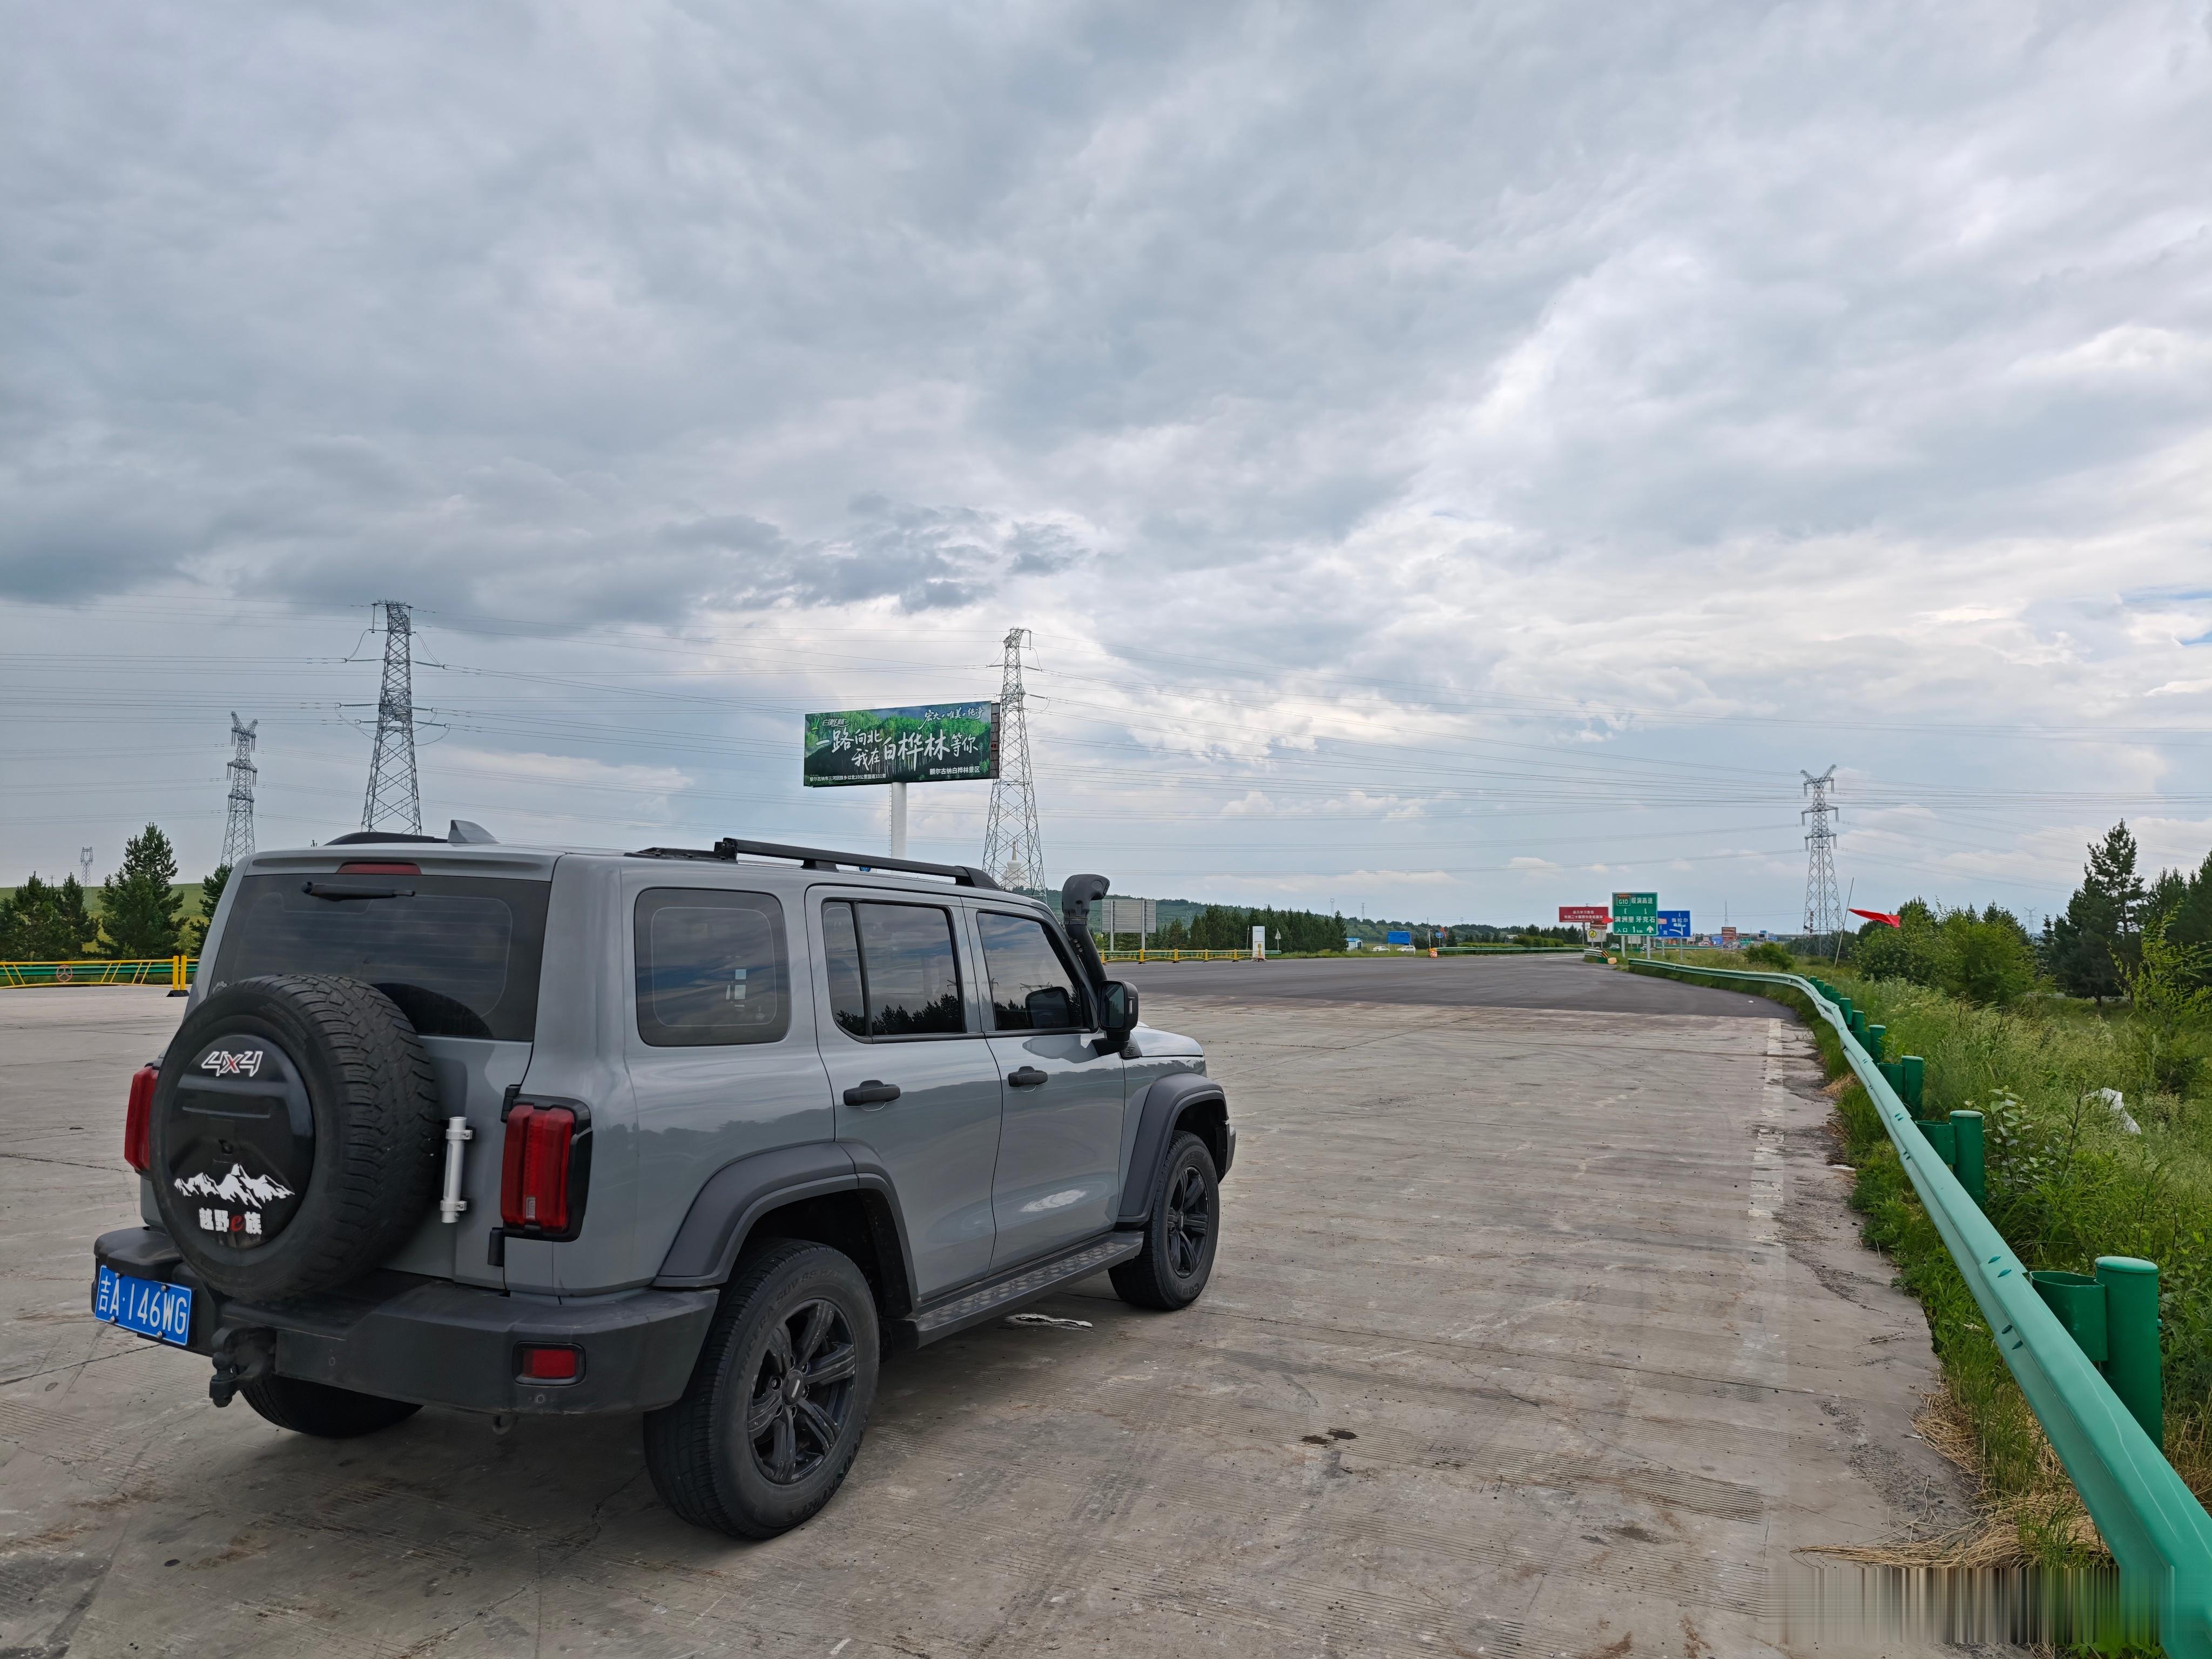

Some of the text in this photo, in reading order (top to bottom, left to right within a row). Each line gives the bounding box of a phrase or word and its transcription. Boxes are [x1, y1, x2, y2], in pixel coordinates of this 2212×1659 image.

[815, 727, 883, 753] 一路向北
[852, 729, 979, 772] 我在白桦林等你
[929, 766, 980, 775] 额尔古纳白桦林景区
[199, 1207, 262, 1235] 越野e族
